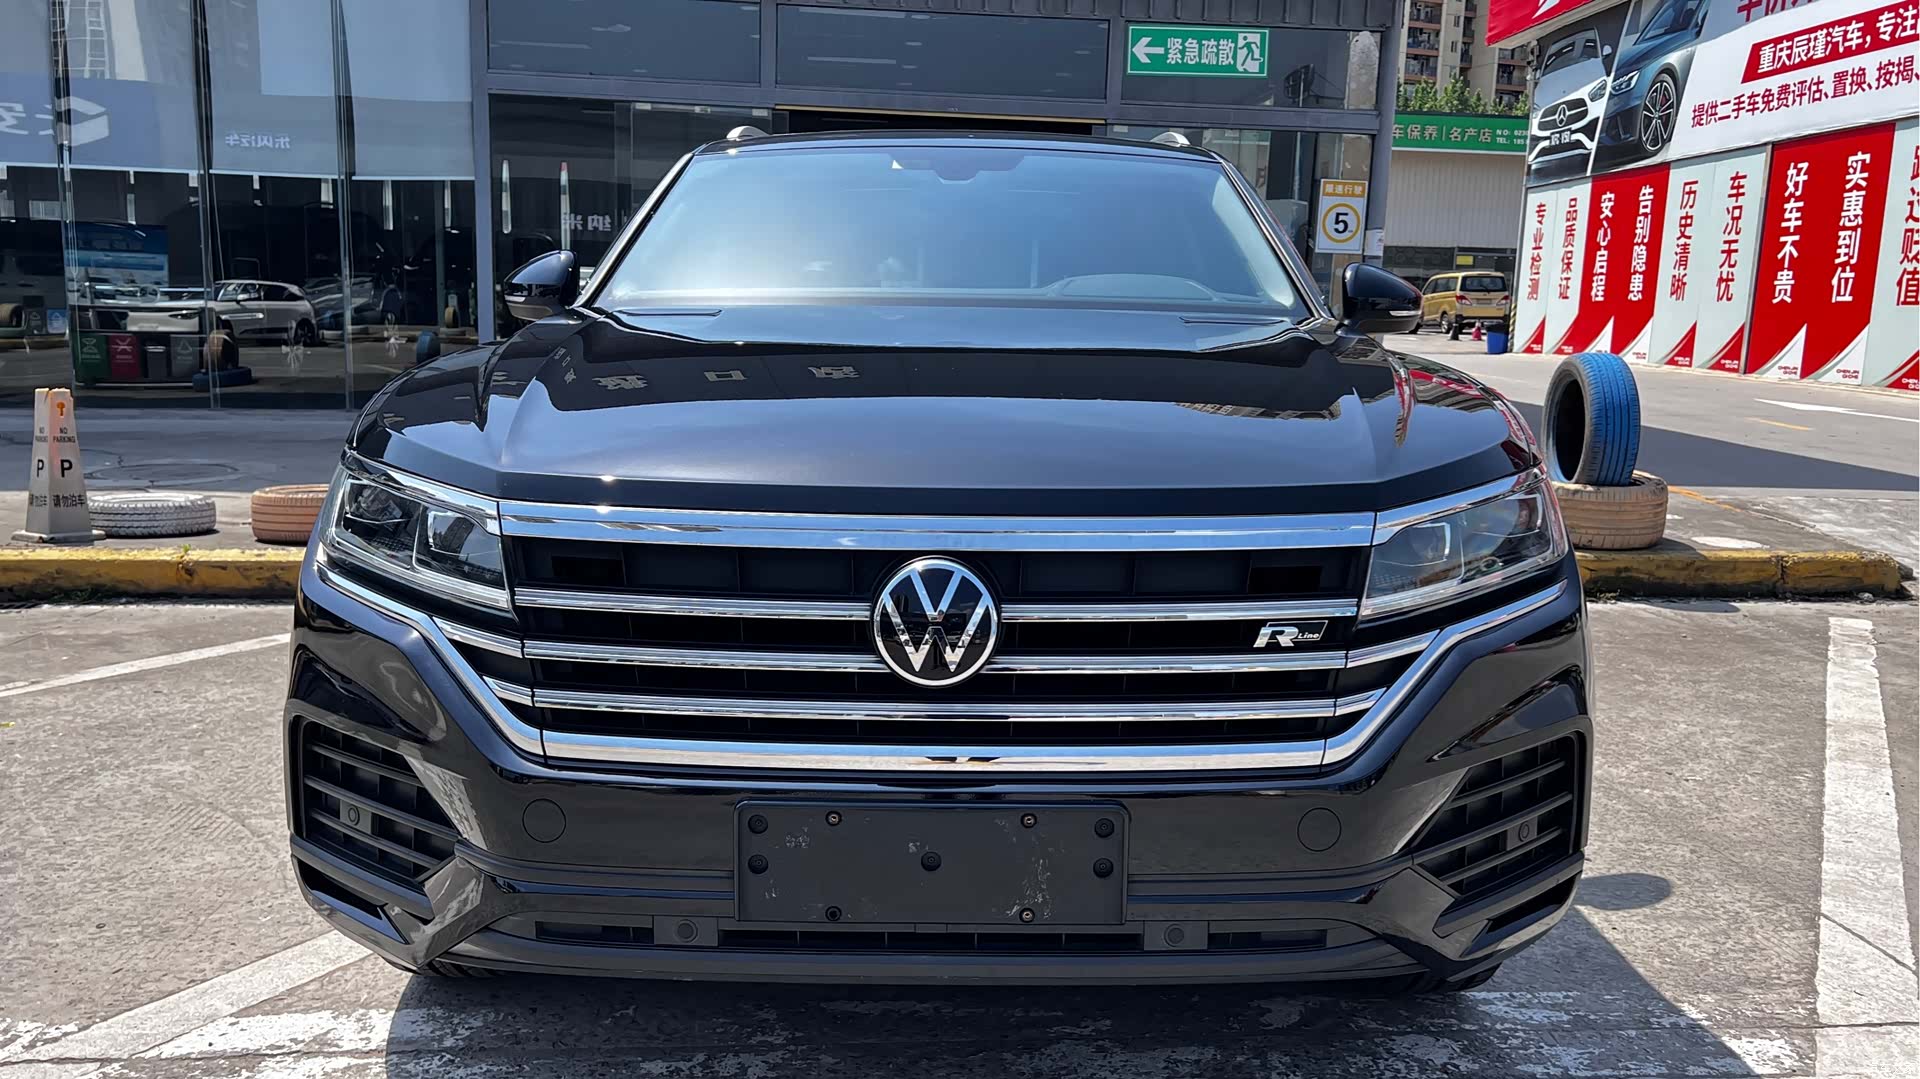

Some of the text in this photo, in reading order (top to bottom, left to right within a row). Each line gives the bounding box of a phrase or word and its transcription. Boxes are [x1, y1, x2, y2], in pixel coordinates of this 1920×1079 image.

[1166, 37, 1235, 66] 紧急疏散
[1757, 5, 1919, 74] 重庆辰瑾汽车，专注
[1333, 212, 1349, 234] 5
[1527, 202, 1546, 301] 专业检测
[1558, 197, 1578, 300] 品质保证
[1591, 191, 1615, 302] 安心启程
[1628, 185, 1654, 301] 告别隐患
[1669, 180, 1699, 302] 历史清晰
[1715, 171, 1747, 303] 车况无忧
[1771, 162, 1809, 305] 好车不贵
[1831, 151, 1871, 303] 实惠到位
[36, 459, 45, 478] P
[53, 435, 76, 443] PARKING
[60, 459, 73, 478] P
[52, 494, 86, 508] 请勿泊车
